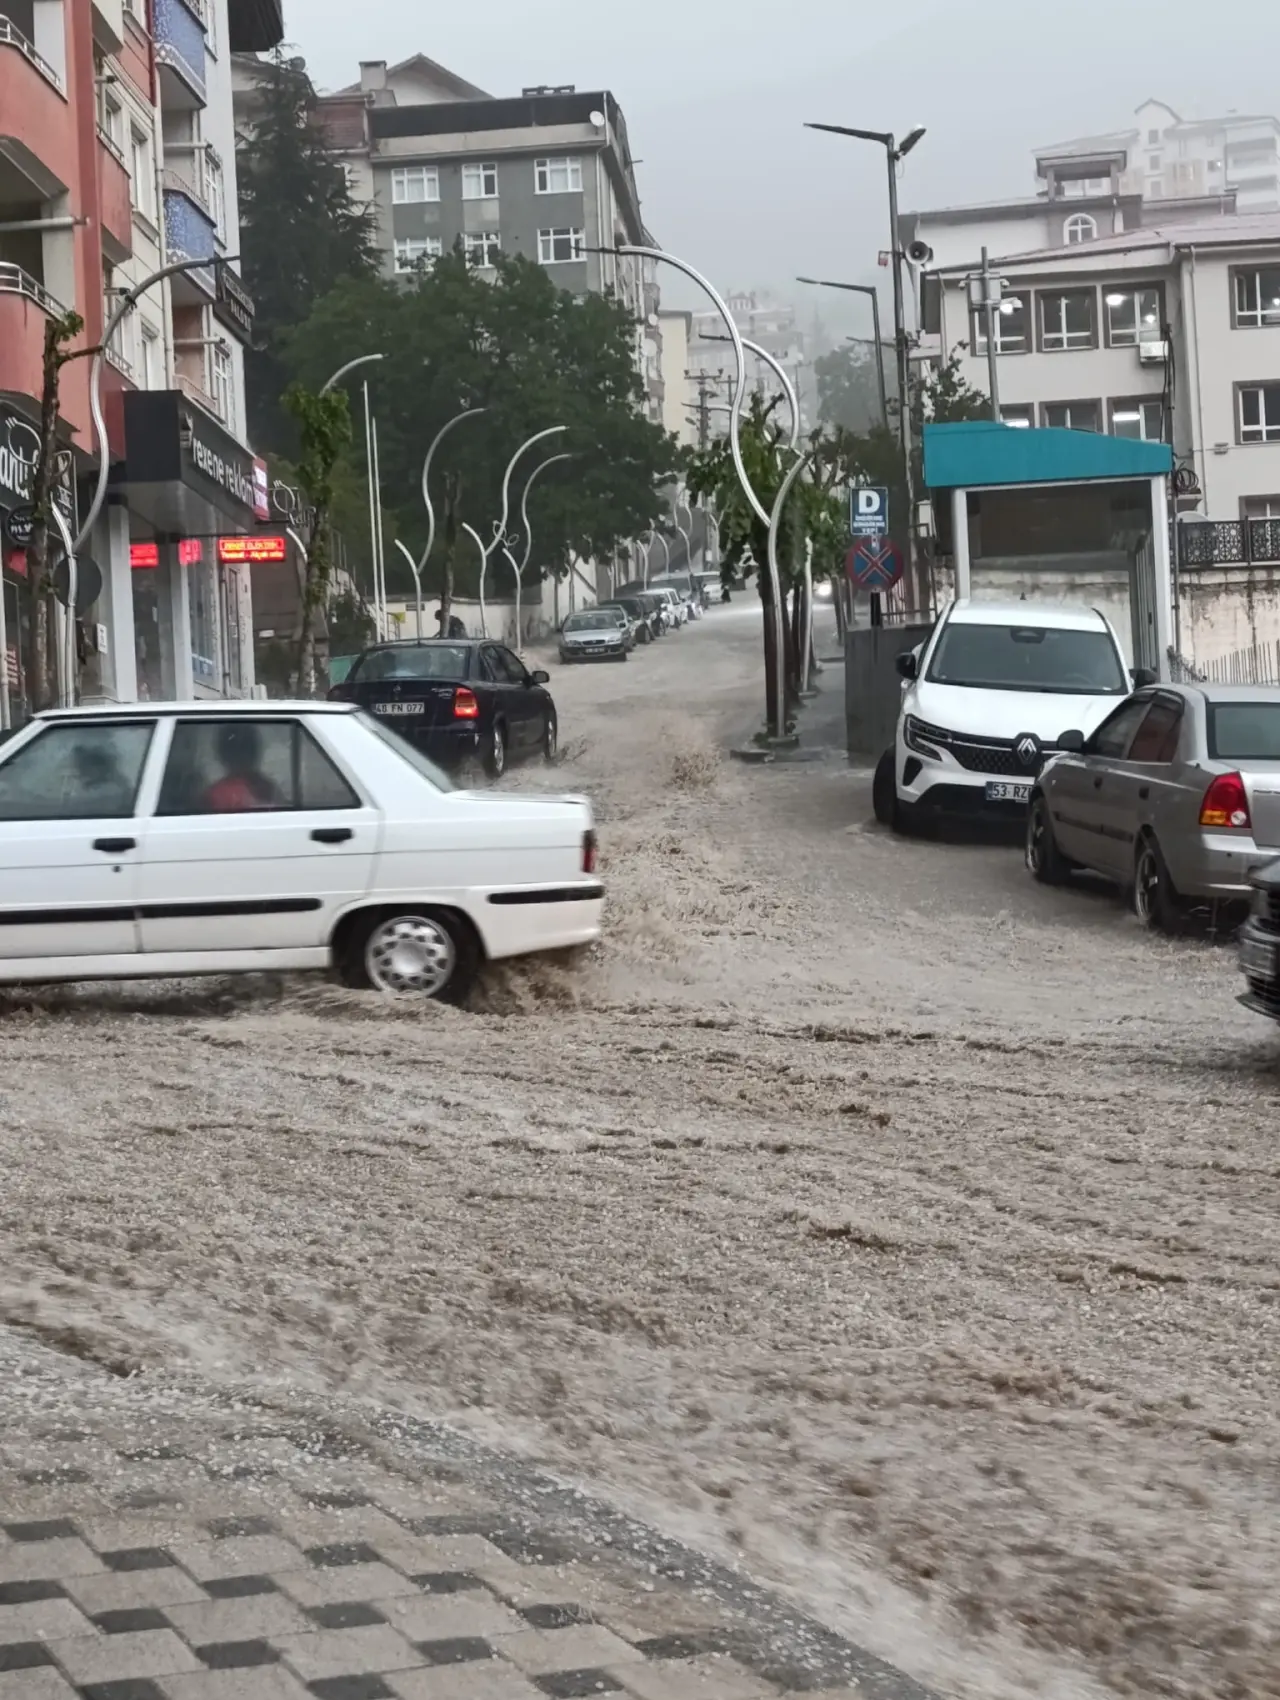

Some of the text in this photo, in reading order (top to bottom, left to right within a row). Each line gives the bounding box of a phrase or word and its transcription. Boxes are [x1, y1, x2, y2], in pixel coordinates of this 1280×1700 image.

[193, 437, 224, 486] rexene
[225, 461, 254, 510] reklam
[859, 490, 880, 513] D
[391, 703, 403, 713] FN
[406, 703, 423, 713] 077
[993, 784, 1008, 798] 53
